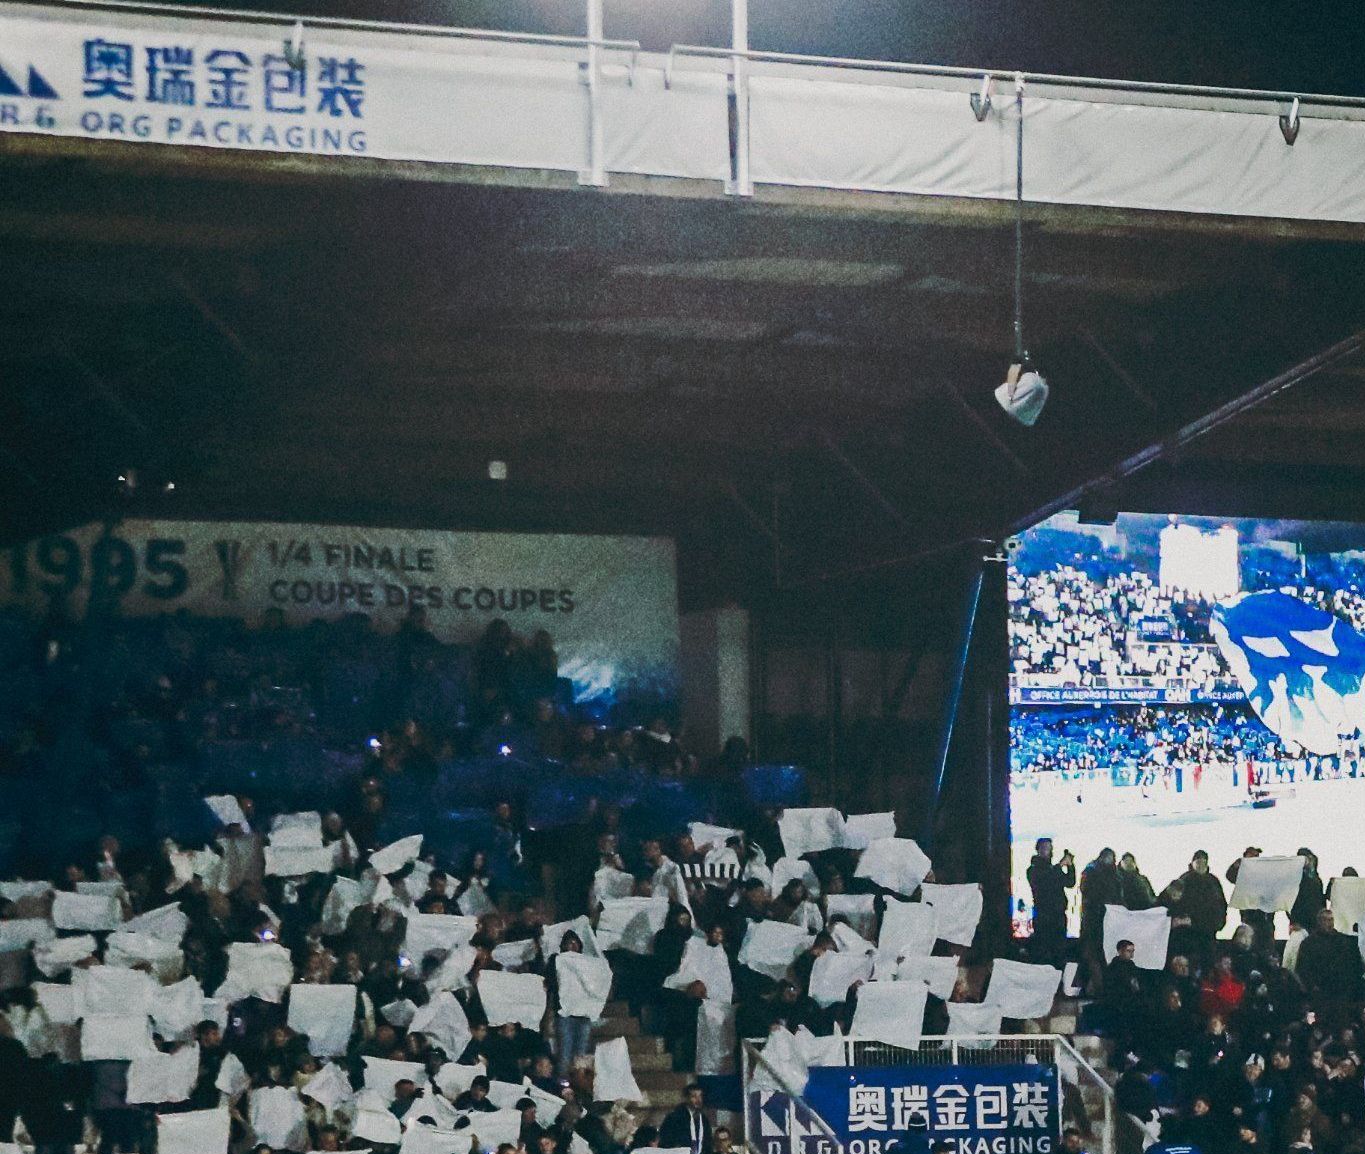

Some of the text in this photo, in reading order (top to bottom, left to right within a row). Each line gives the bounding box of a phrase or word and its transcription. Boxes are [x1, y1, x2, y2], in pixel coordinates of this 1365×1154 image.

[82, 37, 367, 118] 奥瑞金包装
[81, 111, 151, 137] ORG
[167, 117, 368, 152] PACKAGING
[324, 544, 436, 573] FINALE
[269, 578, 576, 614] COUPE DES COUPES
[847, 1081, 1049, 1132] 奥瑞金包装
